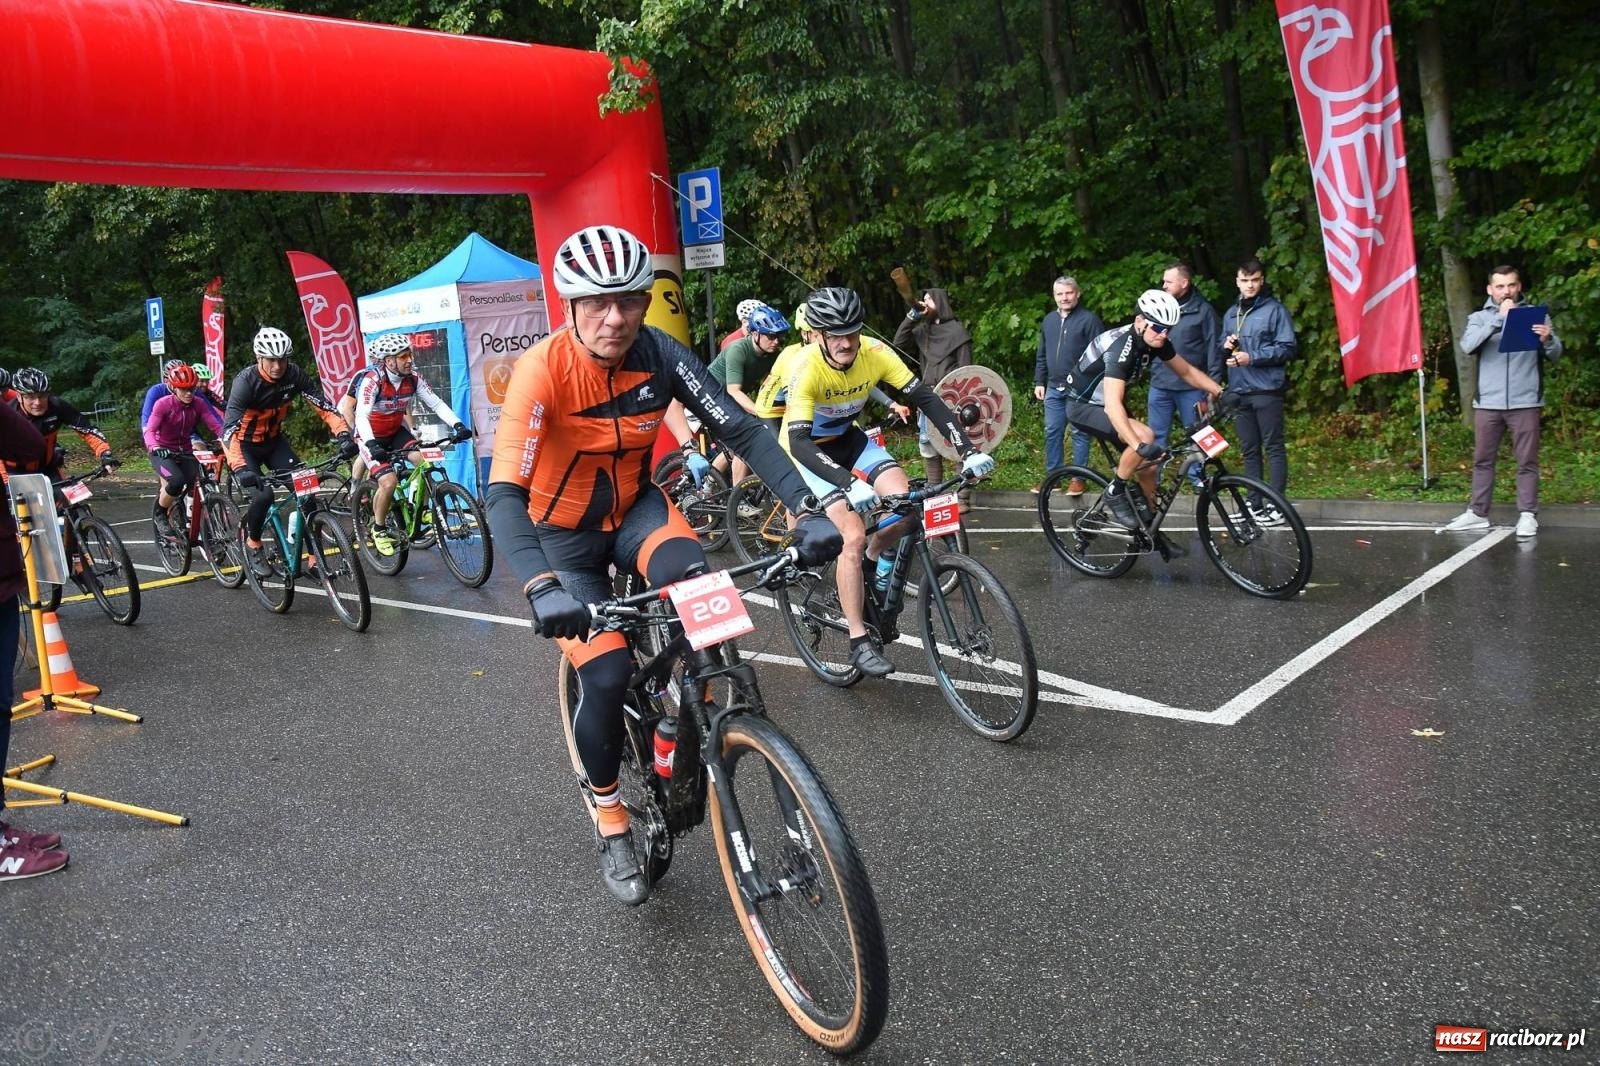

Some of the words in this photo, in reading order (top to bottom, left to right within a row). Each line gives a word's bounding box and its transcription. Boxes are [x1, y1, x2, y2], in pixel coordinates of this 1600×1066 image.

[687, 176, 713, 223] P
[469, 292, 524, 305] PersonalBest
[662, 290, 685, 315] S
[149, 302, 160, 329] P
[480, 332, 550, 354] Person
[675, 360, 701, 397] NUDEL
[699, 392, 730, 425] TEAM
[832, 379, 872, 397] SCOTT
[519, 436, 539, 479] NUDEL
[932, 508, 952, 523] 35
[690, 595, 731, 623] 20
